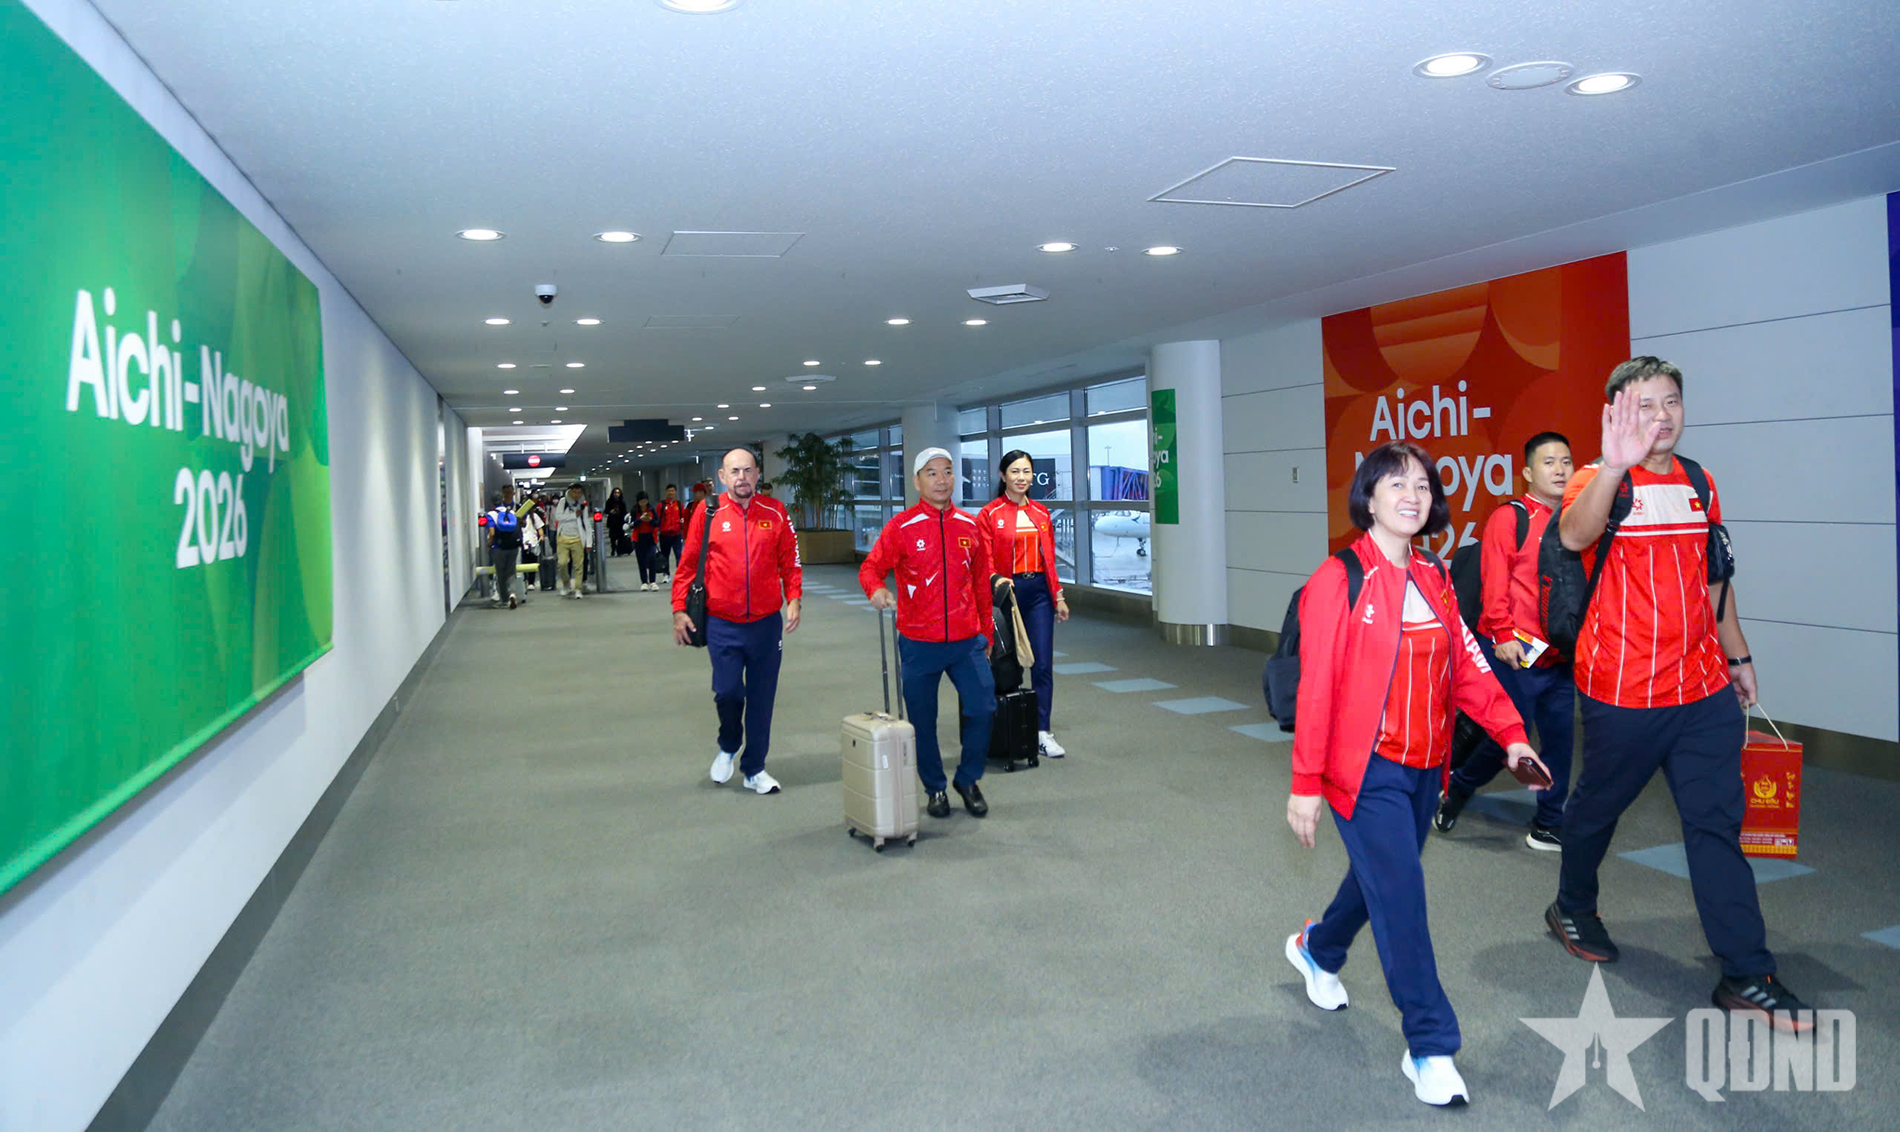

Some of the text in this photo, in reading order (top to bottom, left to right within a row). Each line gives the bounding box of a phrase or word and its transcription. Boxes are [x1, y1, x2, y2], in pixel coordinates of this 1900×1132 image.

[66, 286, 290, 474] Aichi-Nagoya
[1369, 380, 1491, 442] Aichi-
[174, 467, 248, 569] 2026
